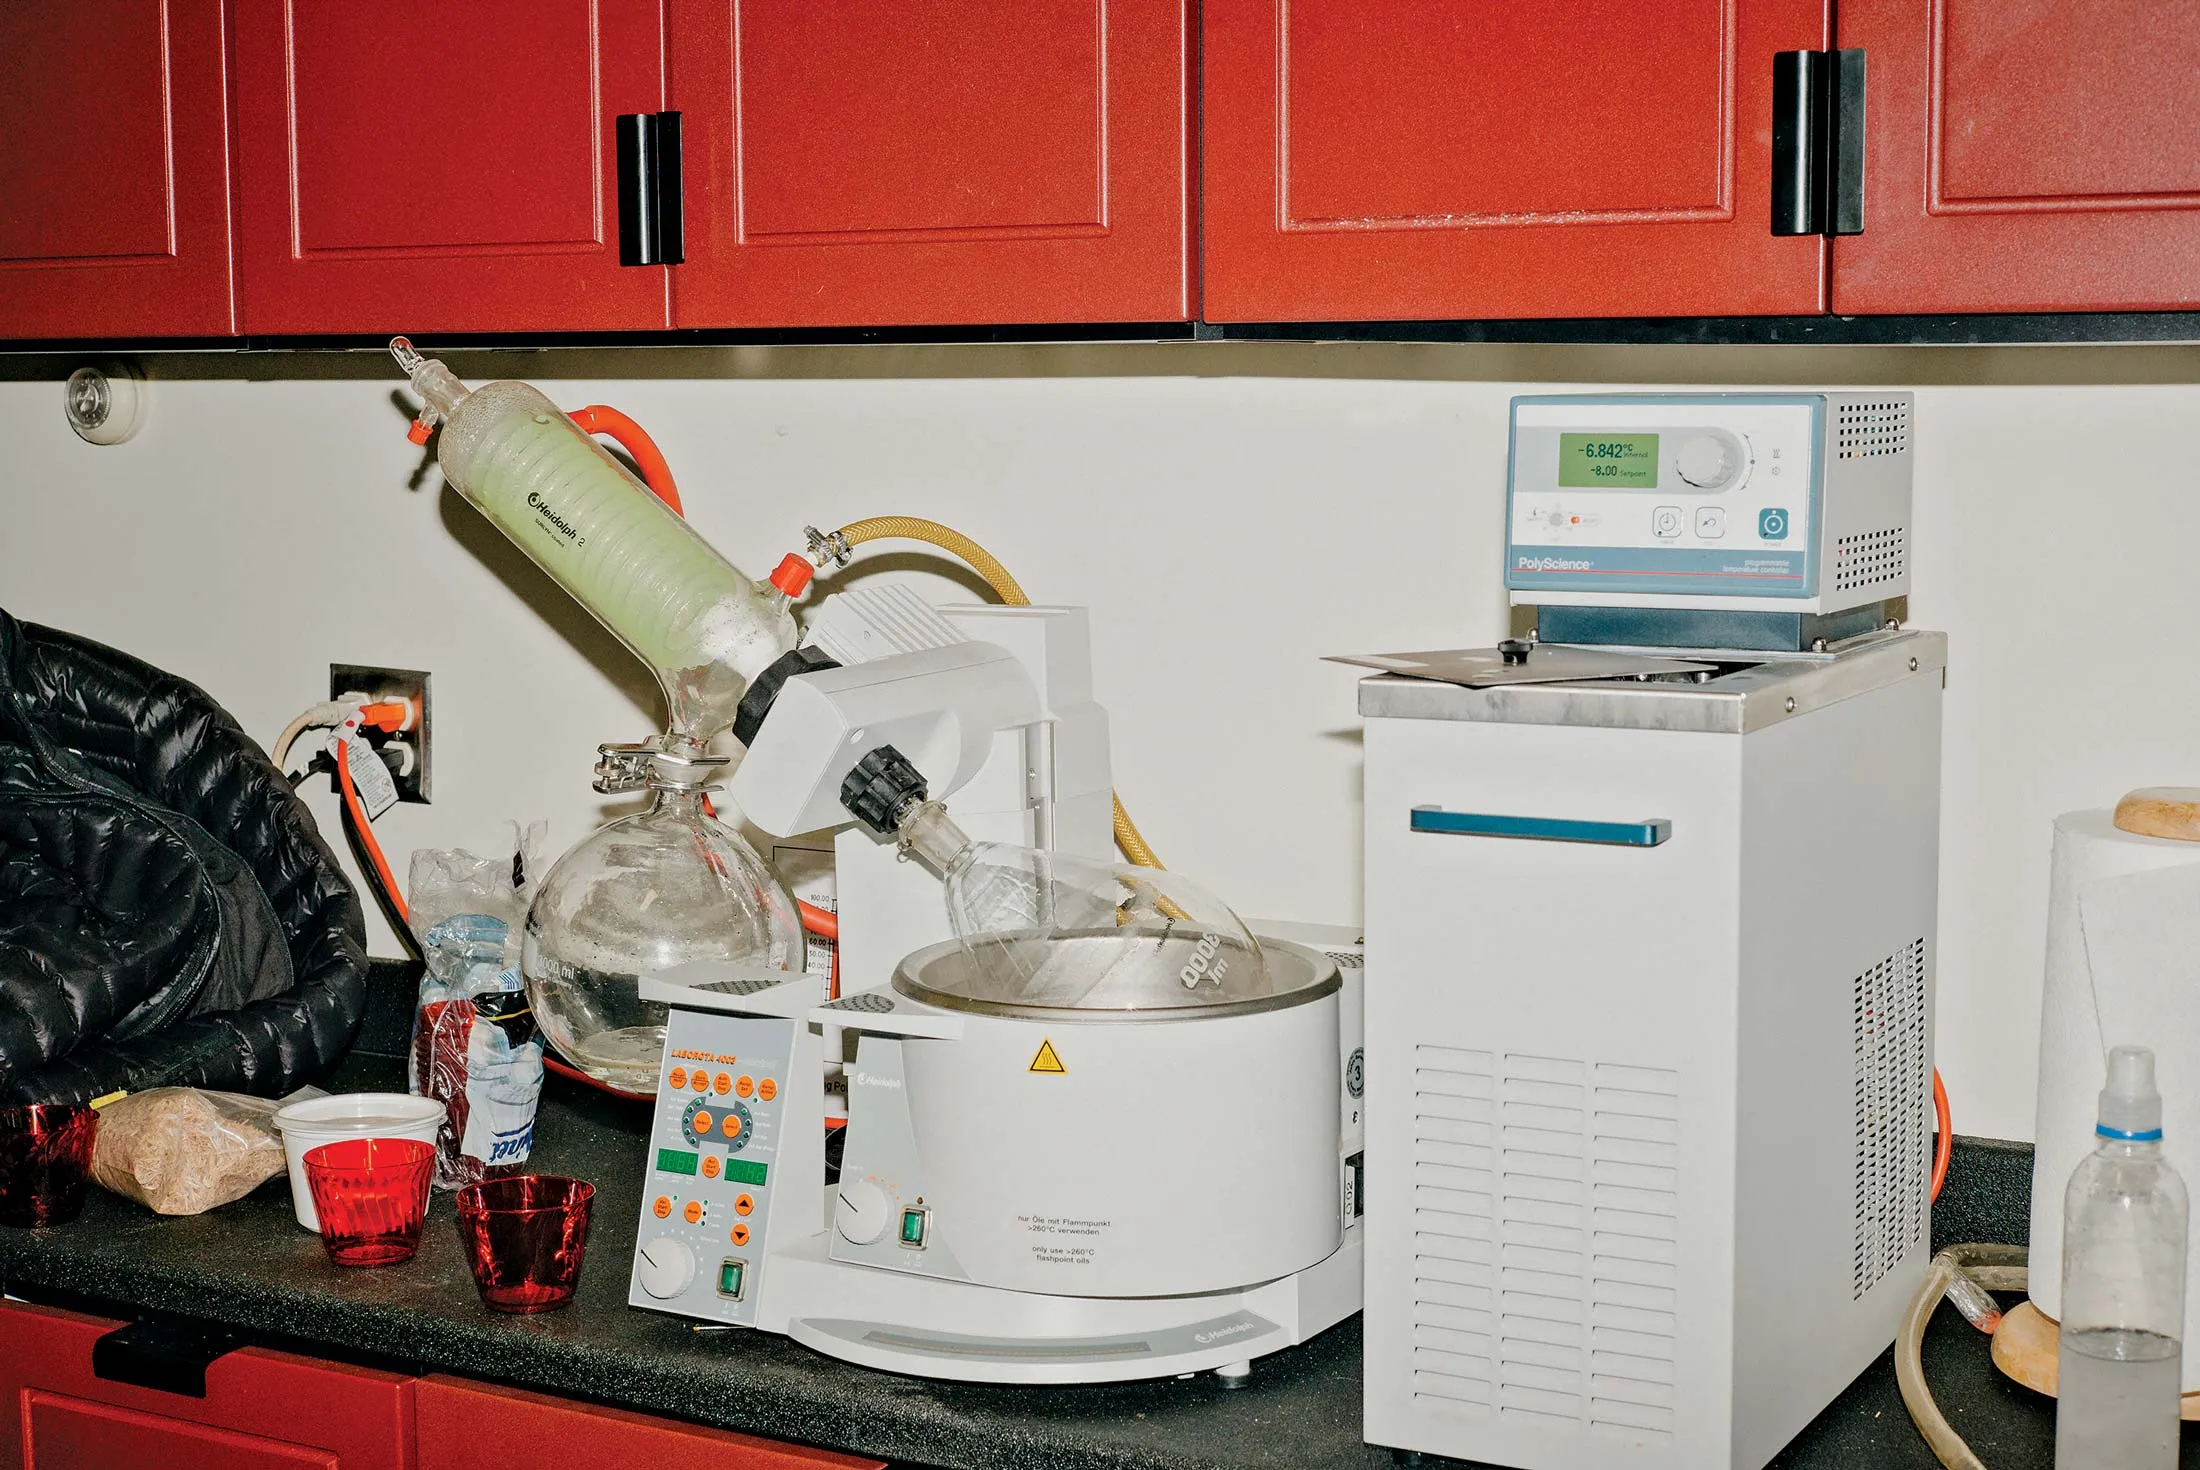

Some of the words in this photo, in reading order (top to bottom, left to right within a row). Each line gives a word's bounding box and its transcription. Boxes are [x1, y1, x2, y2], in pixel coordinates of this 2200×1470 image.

[1591, 465, 1617, 476] -8.00
[536, 502, 577, 539] Heidolph
[577, 537, 586, 547] 2
[1519, 557, 1590, 572] PolyScience
[561, 966, 575, 980] ml
[671, 1049, 714, 1063] LABOROTA
[1062, 1218, 1111, 1228] Flammpunkt
[1057, 1227, 1100, 1236] verwenden
[1032, 1246, 1048, 1254] only
[1036, 1254, 1074, 1265] flashpoint
[1076, 1257, 1091, 1265] oils
